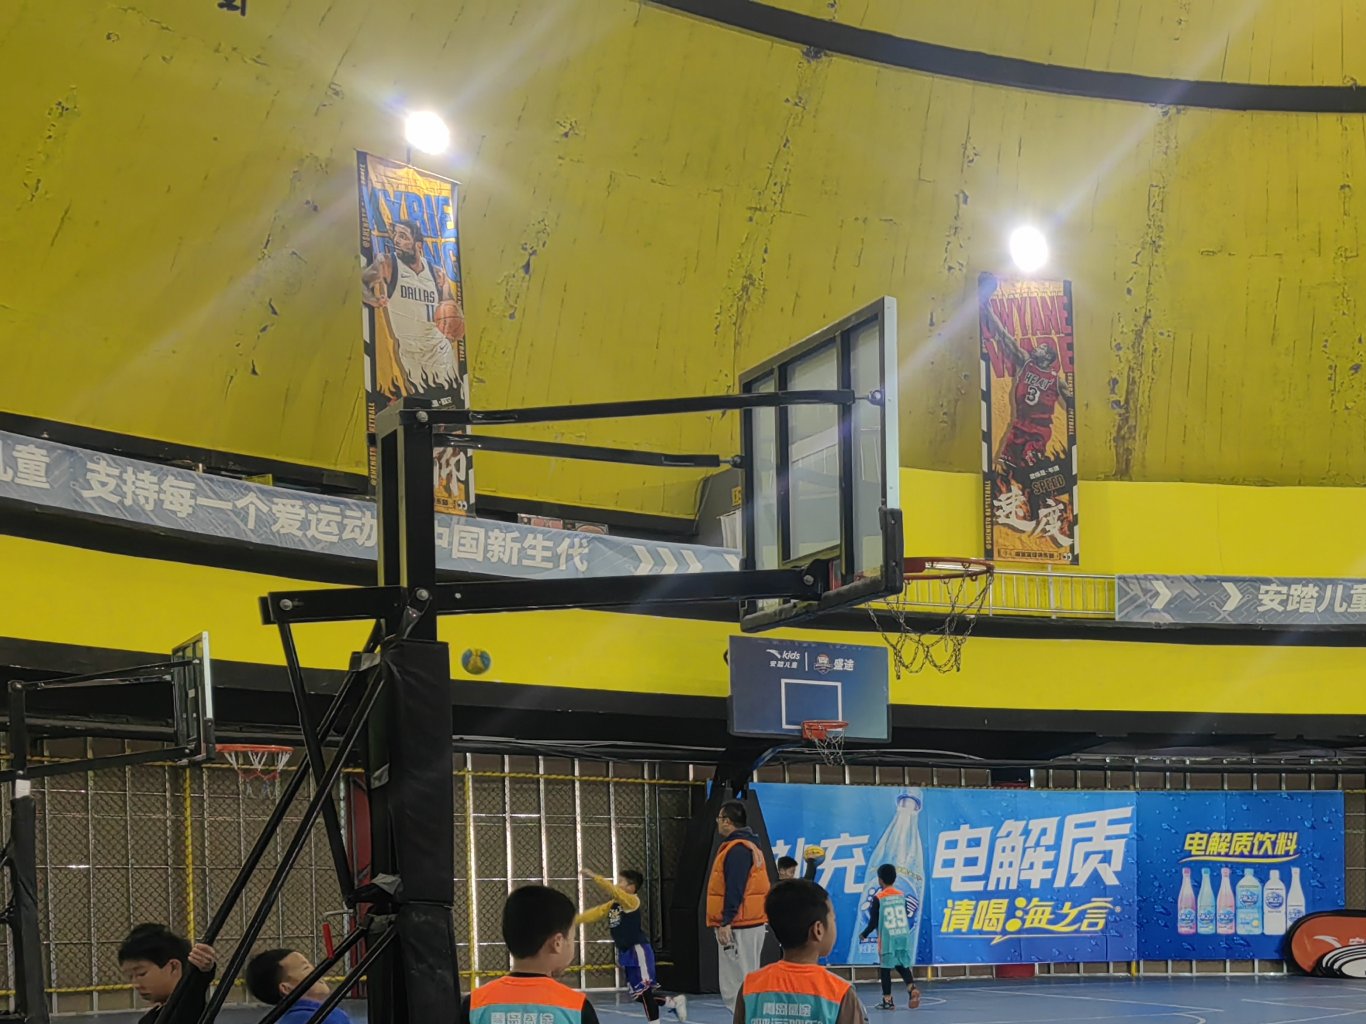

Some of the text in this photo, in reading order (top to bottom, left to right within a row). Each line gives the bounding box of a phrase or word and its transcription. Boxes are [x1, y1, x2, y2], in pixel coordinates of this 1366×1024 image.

[400, 284, 435, 304] DALLAS
[1024, 371, 1054, 391] HEAT
[1024, 385, 1041, 406] 3
[1032, 474, 1066, 495] SPEED
[993, 482, 1074, 548] 速度
[782, 650, 800, 660] kids
[833, 658, 854, 671] 盛途
[932, 806, 1135, 893] 电解质
[1184, 831, 1298, 856] 电解质饮料
[883, 905, 909, 929] 39
